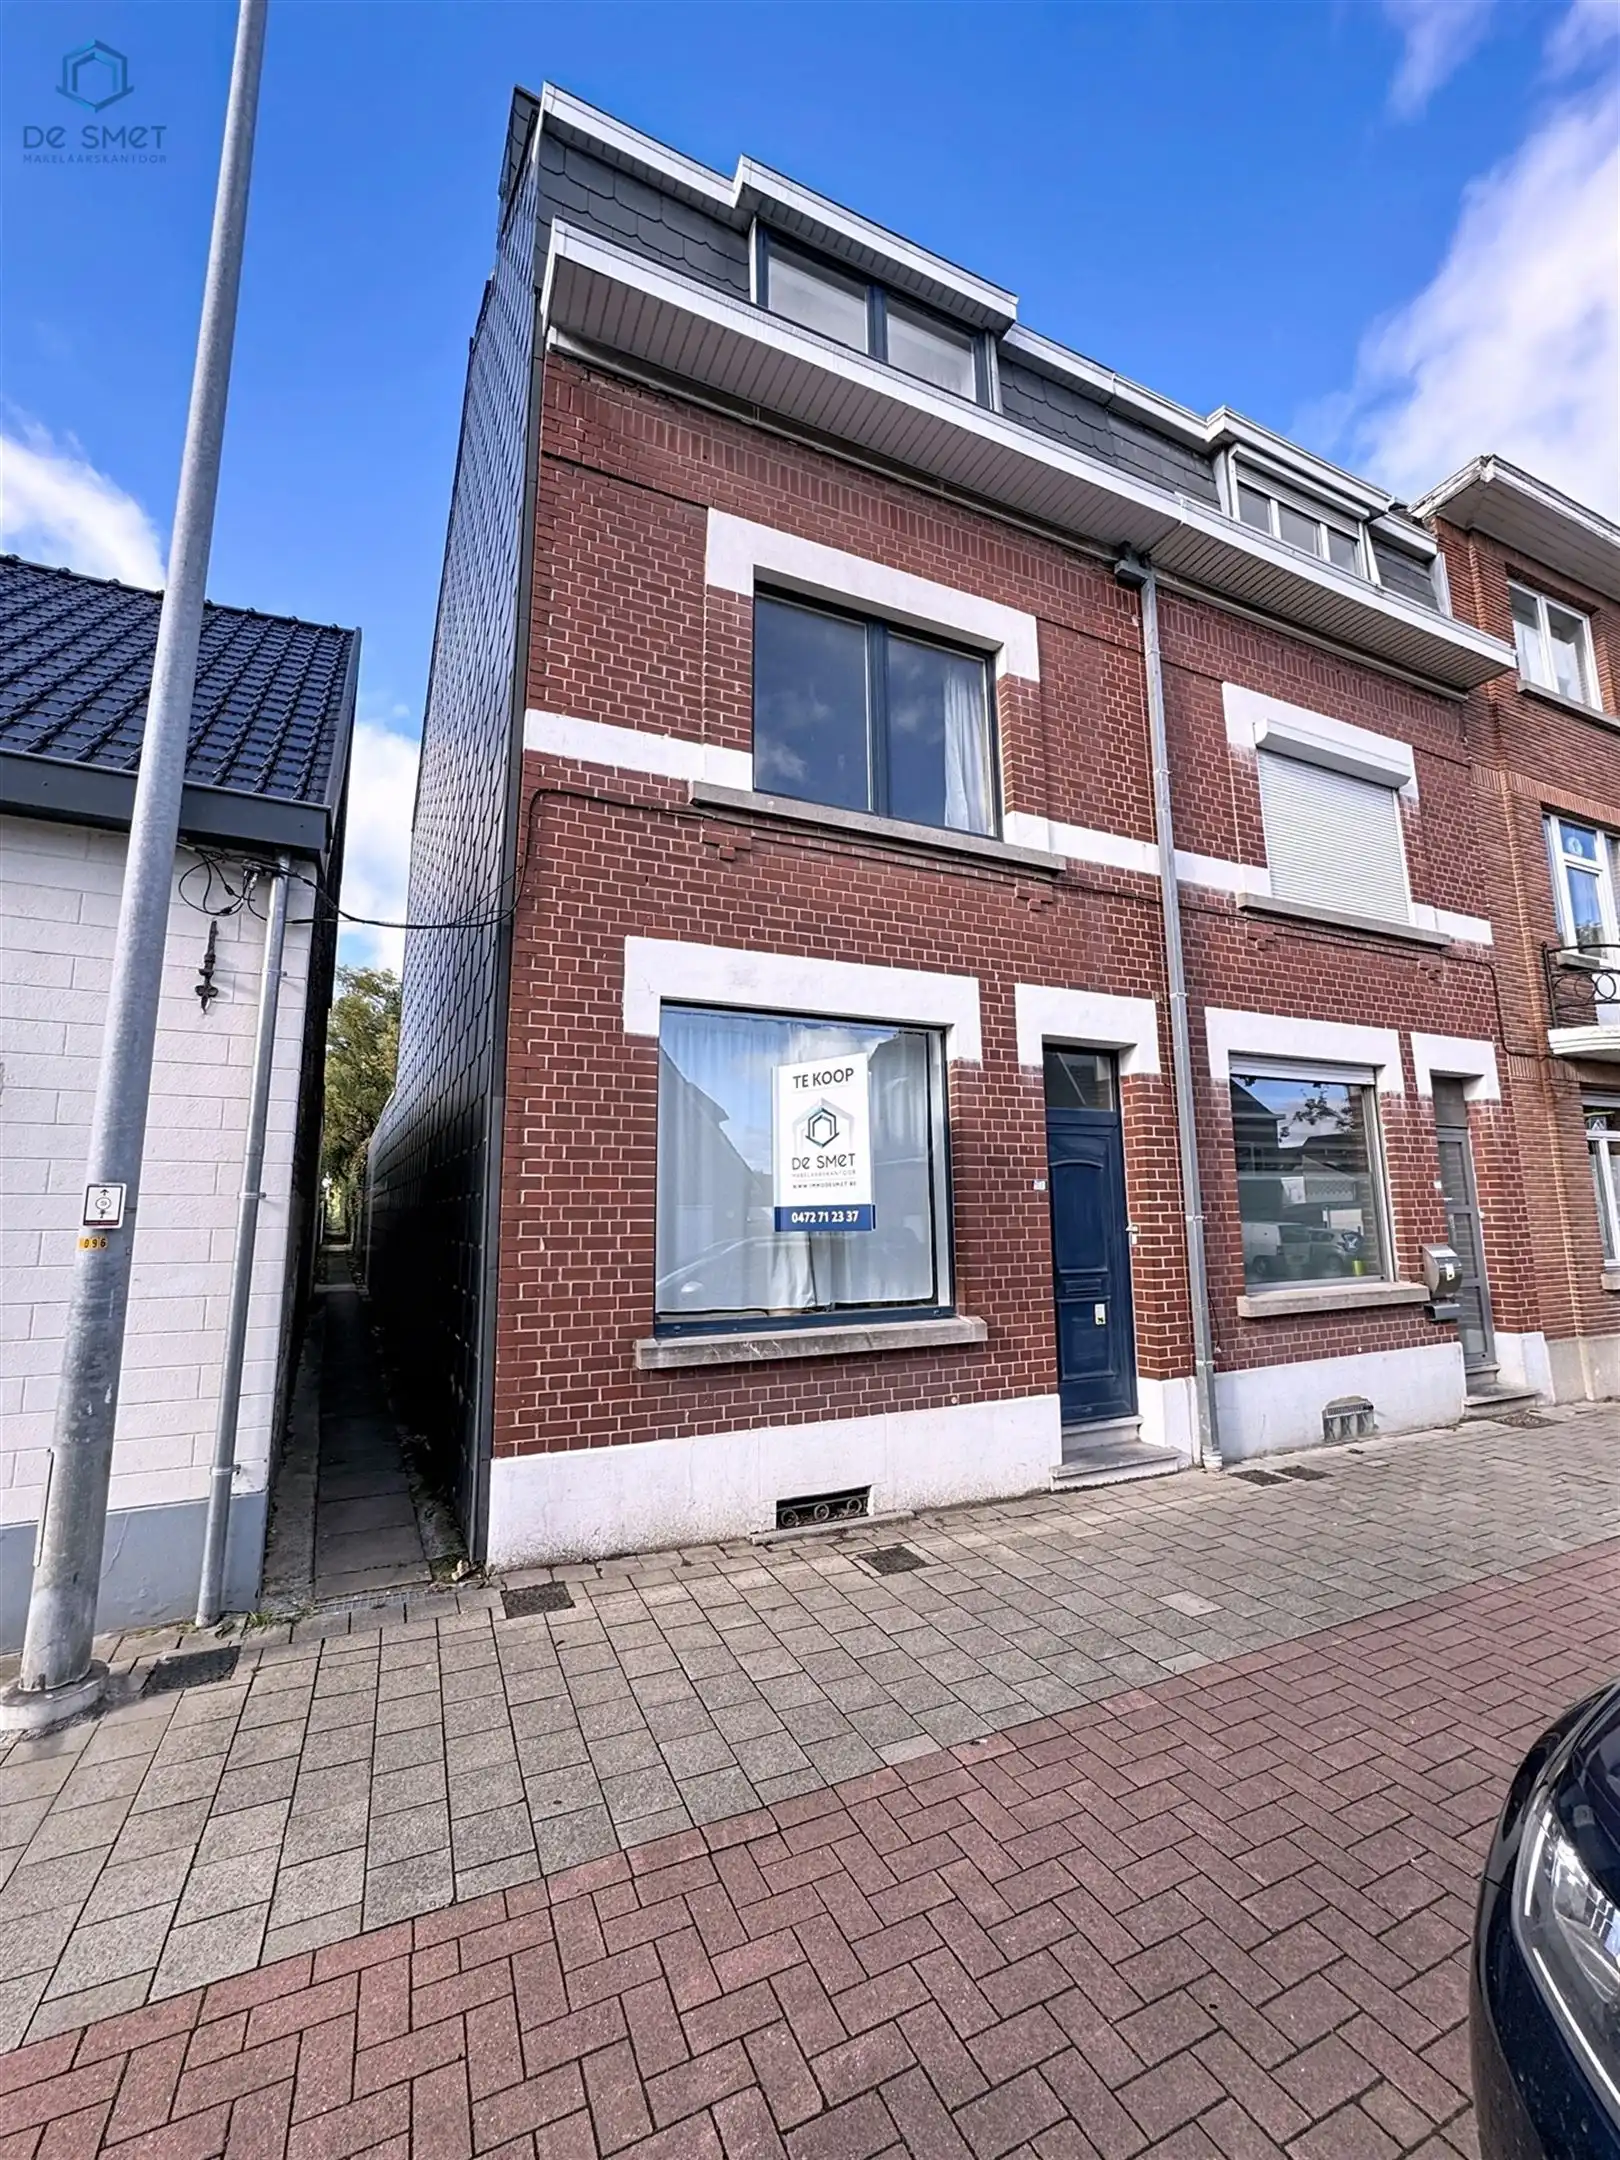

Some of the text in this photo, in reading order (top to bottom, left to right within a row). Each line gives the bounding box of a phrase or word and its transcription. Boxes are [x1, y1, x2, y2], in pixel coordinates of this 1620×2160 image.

[793, 1068, 855, 1089] TE KOOP
[791, 1210, 860, 1223] 0472 71 23 37
[83, 1238, 106, 1249] 096
